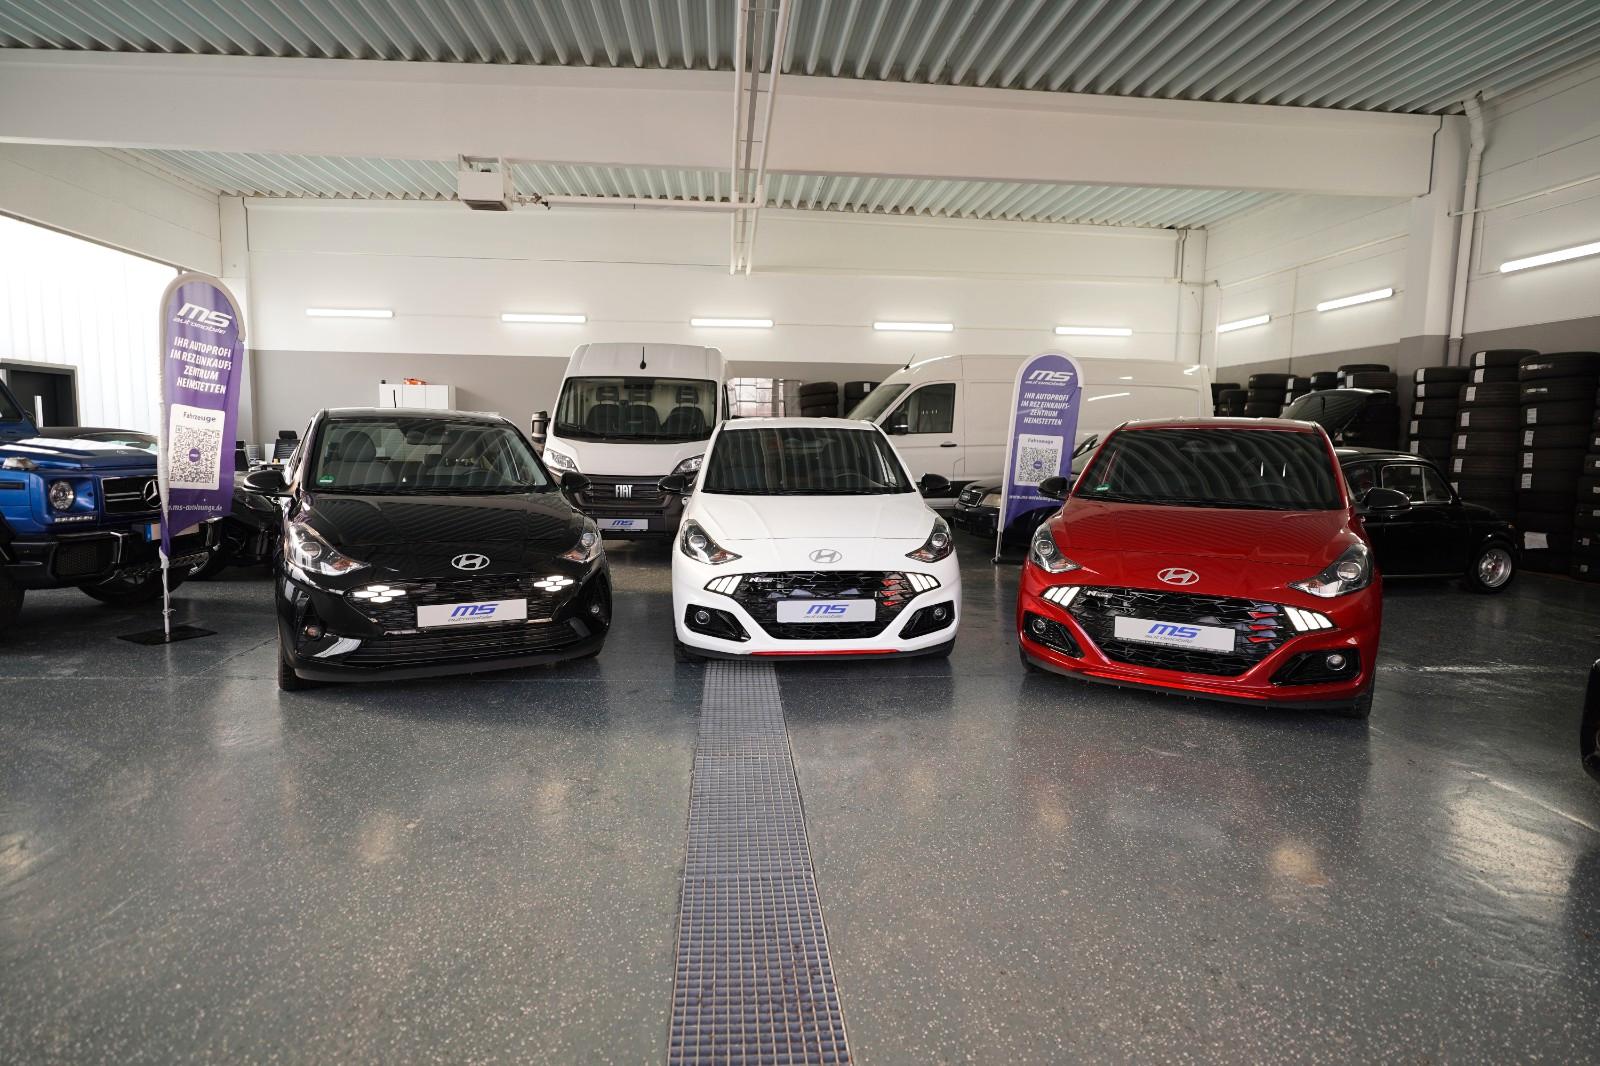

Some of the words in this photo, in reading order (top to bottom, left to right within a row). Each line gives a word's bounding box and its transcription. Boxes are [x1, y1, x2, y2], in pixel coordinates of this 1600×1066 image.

[174, 336, 190, 348] IHR
[189, 341, 231, 358] AUTOPROFI
[170, 349, 182, 360] IM
[184, 365, 220, 380] ZENTRUM
[177, 377, 227, 394] HEIMSTETTEN
[1024, 392, 1036, 400] IHR
[1035, 393, 1069, 402] AUTOPROFI
[1020, 400, 1030, 408] IM
[183, 411, 217, 423] Fahrzeuge
[1030, 408, 1058, 417] ZENTRUM
[1023, 417, 1063, 425] HEIMSTETTEN
[615, 484, 633, 498] FIAT
